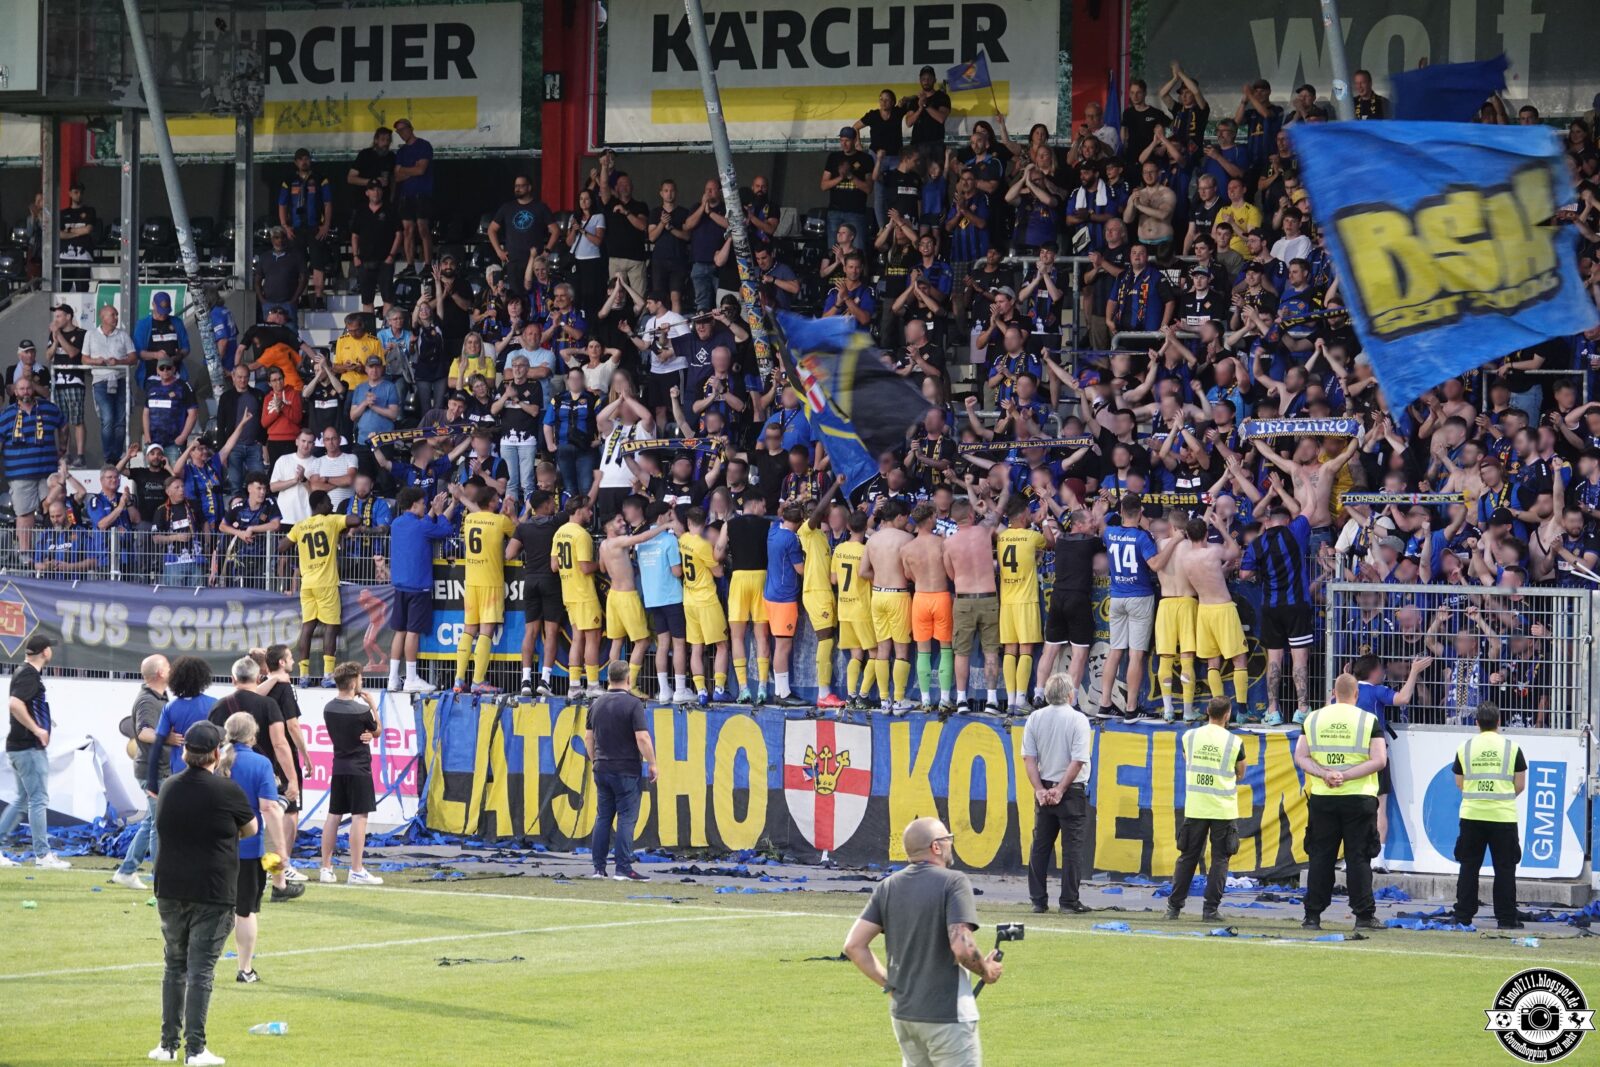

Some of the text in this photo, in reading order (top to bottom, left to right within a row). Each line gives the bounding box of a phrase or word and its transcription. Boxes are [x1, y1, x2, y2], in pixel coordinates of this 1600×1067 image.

[651, 2, 1010, 72] KÄRCHER
[621, 439, 670, 453] ORZA
[301, 531, 330, 560] 19
[469, 527, 483, 554] 6
[556, 541, 573, 570] 30
[1002, 544, 1019, 573] 4
[1108, 543, 1139, 574] 14
[841, 562, 853, 592] 7
[56, 600, 130, 648] TUS
[147, 600, 347, 651] SCHÄNG
[1327, 753, 1345, 765] 0292
[422, 699, 769, 851] LATSHO
[1196, 773, 1214, 786] 0889
[1477, 780, 1494, 792] 0892
[1532, 767, 1558, 861] GMBH
